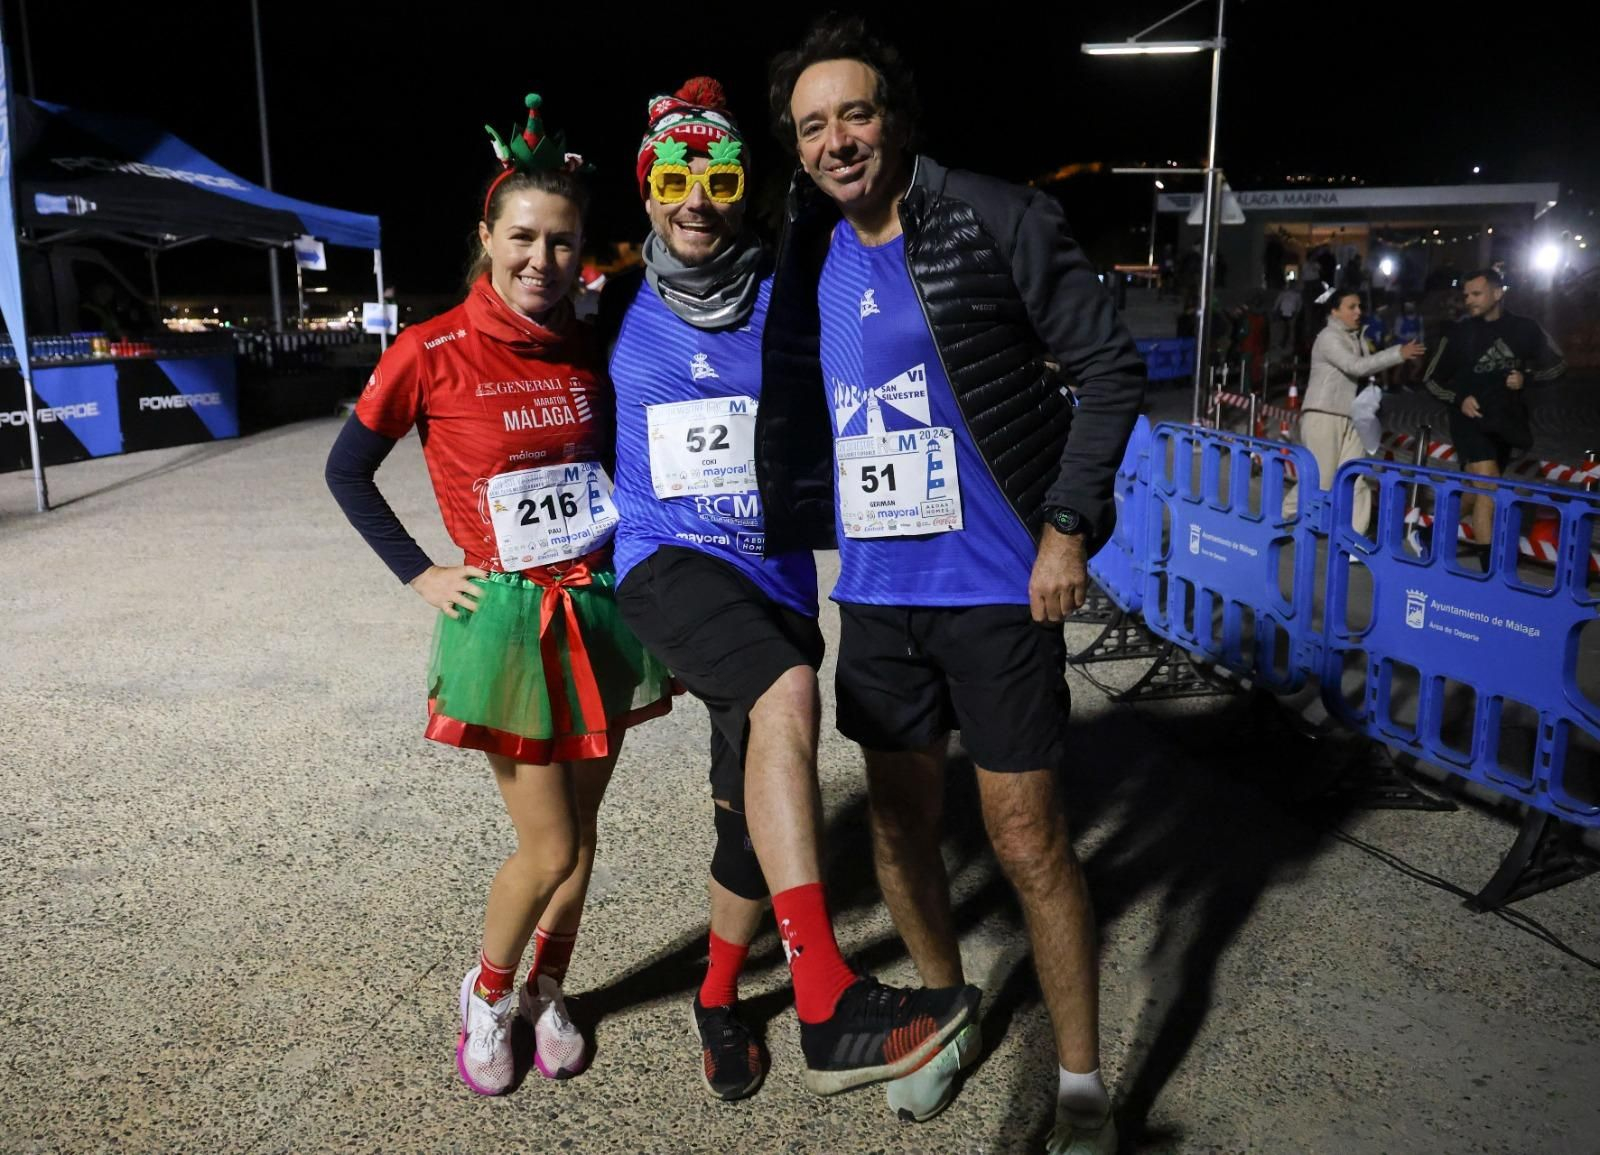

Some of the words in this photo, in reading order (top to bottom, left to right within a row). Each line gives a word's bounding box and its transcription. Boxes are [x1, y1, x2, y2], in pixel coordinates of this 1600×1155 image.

[1282, 191, 1338, 205] MARINA
[424, 331, 456, 350] luanvi
[907, 369, 924, 383] VI
[495, 378, 563, 394] GENERALI
[881, 384, 897, 393] SAN
[139, 393, 220, 411] POWERADE
[533, 396, 567, 408] MARATÓN
[882, 390, 926, 401] SILVESTRE
[503, 405, 576, 432] MÁLAGA
[686, 424, 730, 453] 52
[509, 450, 547, 462] málaga
[702, 458, 717, 466] COKI
[703, 464, 747, 477] mayoral
[861, 463, 897, 493] 51
[517, 492, 578, 526] 216
[694, 495, 759, 518] RCM
[877, 506, 919, 519] mayoral
[548, 528, 562, 536] PAU
[550, 529, 591, 545] mayoral
[675, 532, 730, 545] mayoral
[1430, 600, 1490, 623] Ayuntamiento
[1491, 616, 1503, 627] de
